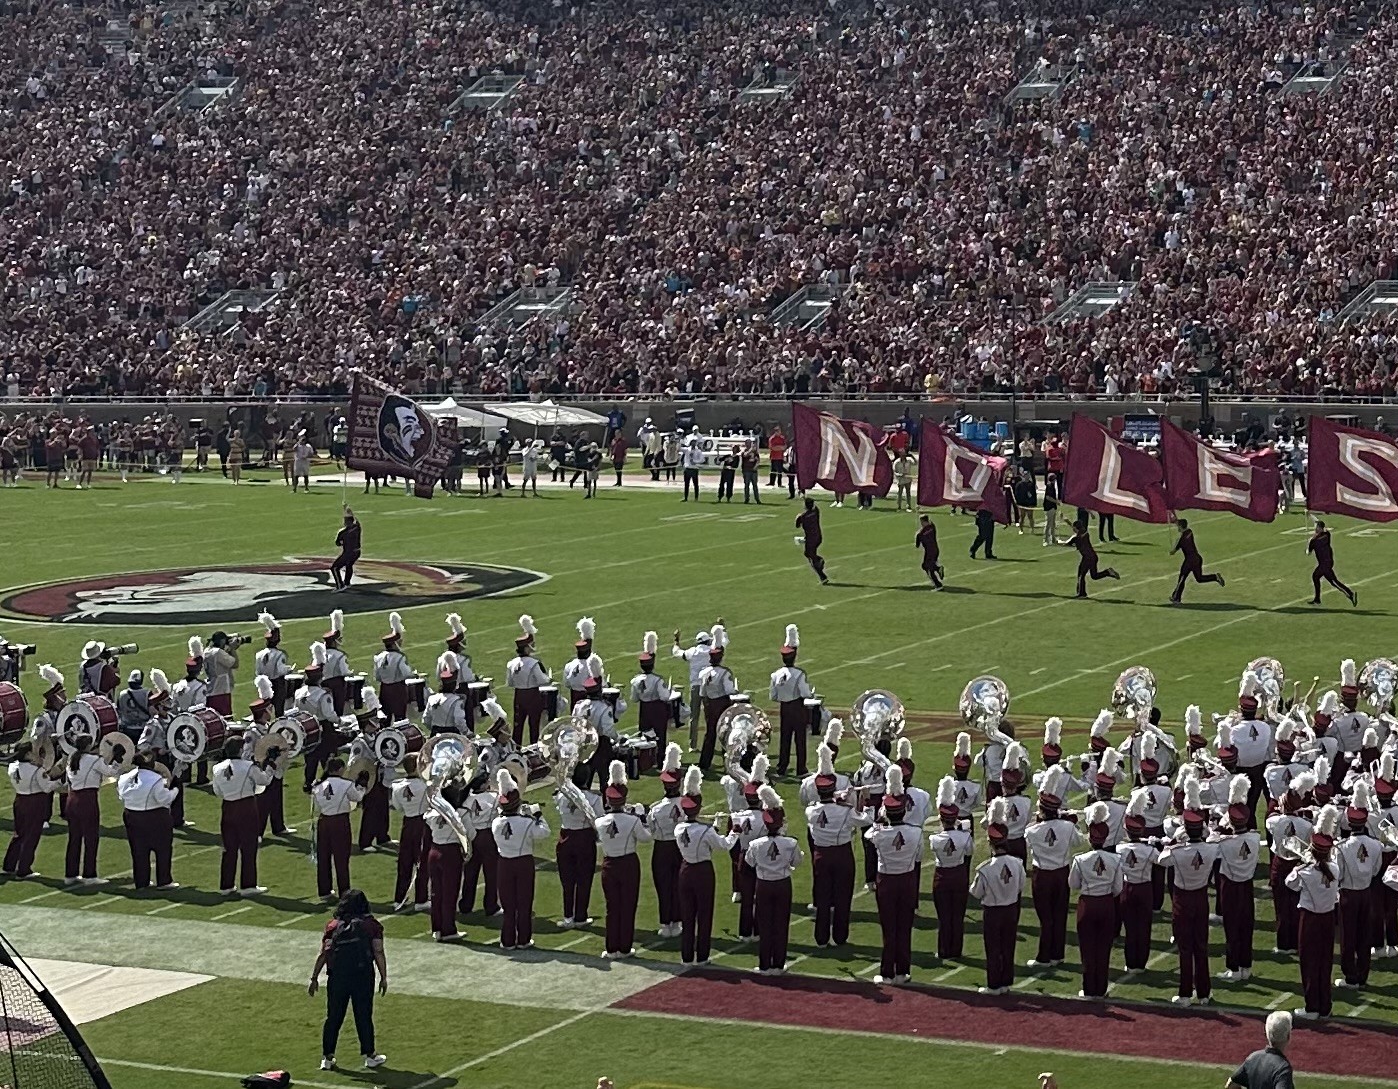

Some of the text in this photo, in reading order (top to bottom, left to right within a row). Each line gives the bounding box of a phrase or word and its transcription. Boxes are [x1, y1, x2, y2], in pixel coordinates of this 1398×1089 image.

[816, 410, 878, 487] N
[1090, 428, 1149, 513] L
[1194, 441, 1251, 508] E
